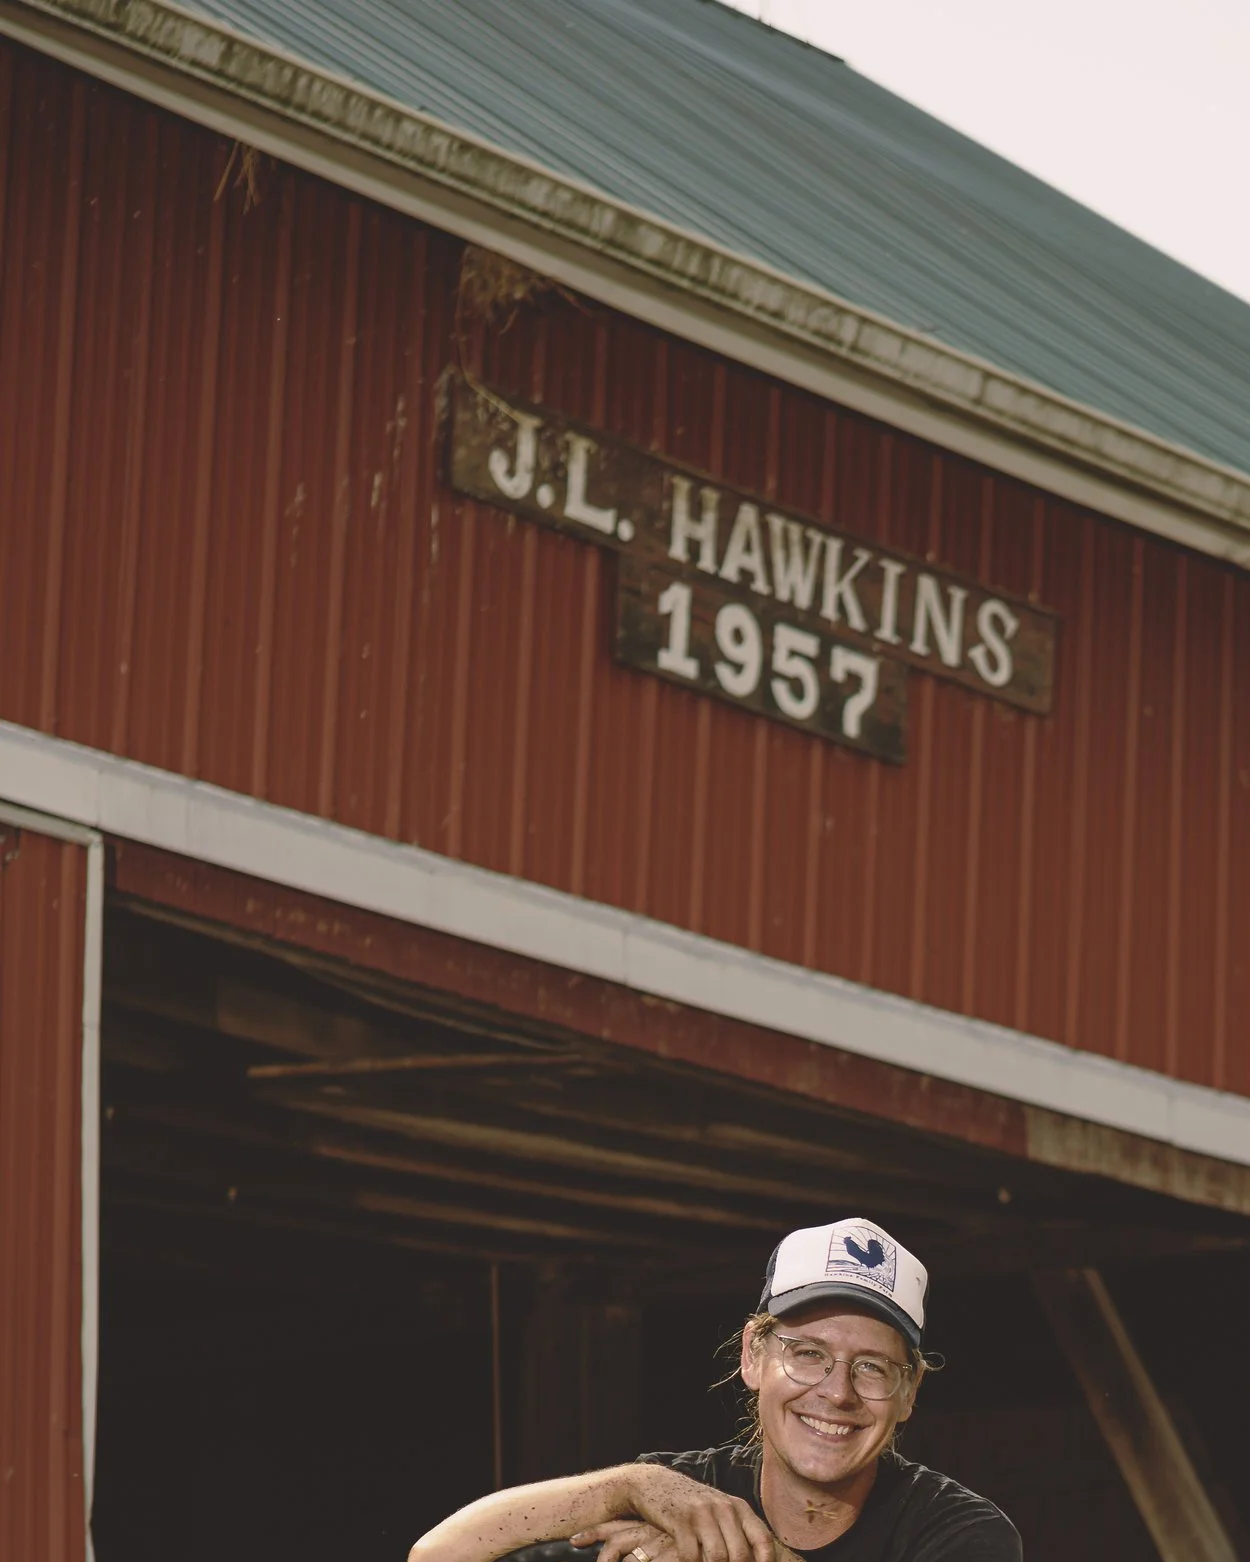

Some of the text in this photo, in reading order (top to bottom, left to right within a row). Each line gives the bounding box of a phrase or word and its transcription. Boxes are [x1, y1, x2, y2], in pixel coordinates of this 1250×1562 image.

[488, 414, 1020, 688] J.L. HAWKINS
[656, 582, 881, 740] 1957
